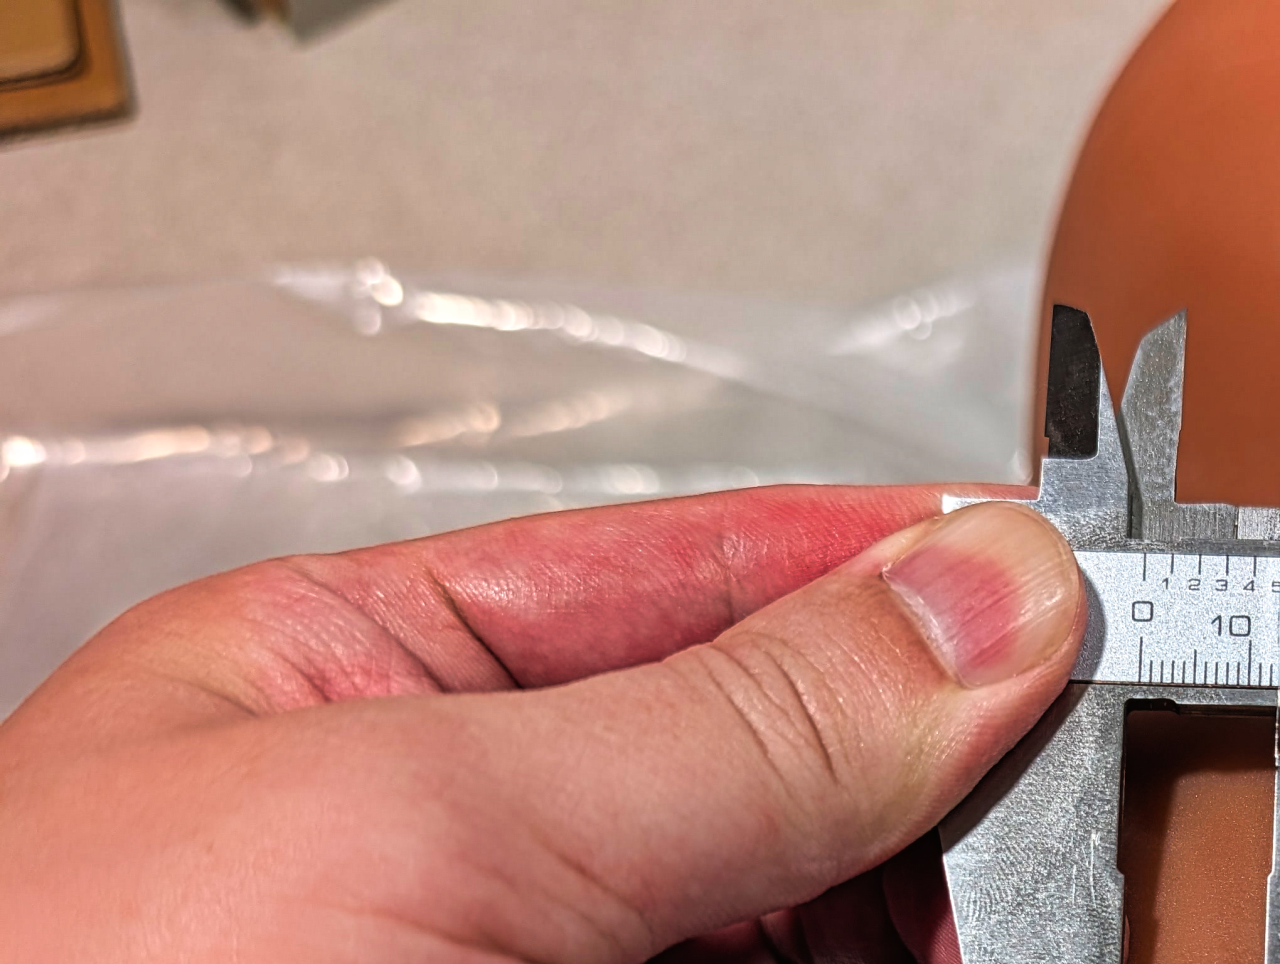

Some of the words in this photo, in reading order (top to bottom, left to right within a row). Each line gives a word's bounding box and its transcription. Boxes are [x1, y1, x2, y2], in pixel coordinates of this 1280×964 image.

[1161, 578, 1169, 589] 1
[1188, 578, 1201, 591] 2
[1215, 579, 1228, 592] 3
[1242, 579, 1256, 592] 4
[1131, 600, 1154, 622] 0
[1211, 614, 1251, 637] 10
